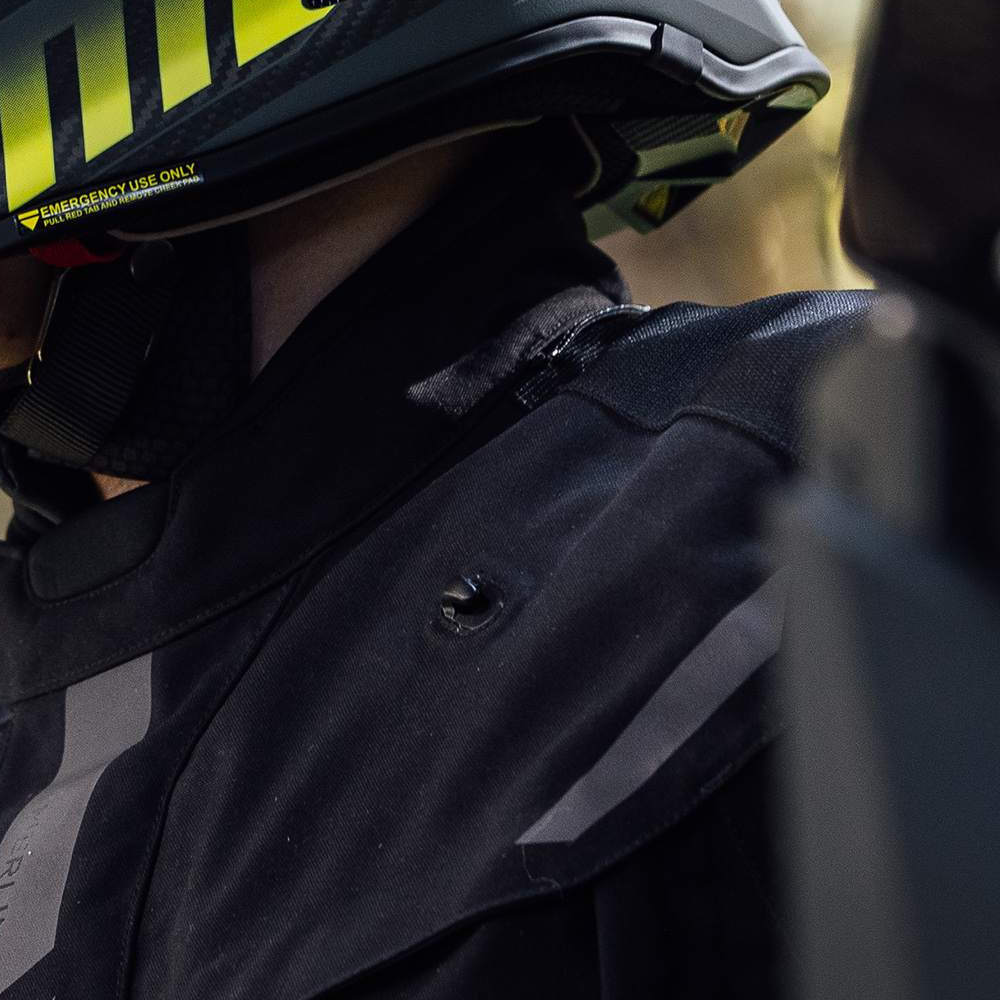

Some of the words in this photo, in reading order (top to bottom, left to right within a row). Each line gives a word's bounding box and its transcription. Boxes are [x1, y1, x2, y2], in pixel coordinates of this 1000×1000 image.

[41, 183, 126, 218] EMERGENCY
[129, 174, 157, 191] USE
[159, 163, 195, 182] ONLY
[43, 214, 66, 227] PULL
[66, 209, 83, 220] RED
[83, 204, 101, 215] TAB
[101, 199, 119, 210] AND
[119, 188, 154, 204] REMOVE
[154, 180, 183, 194] CHEEK
[182, 175, 200, 185] PAD
